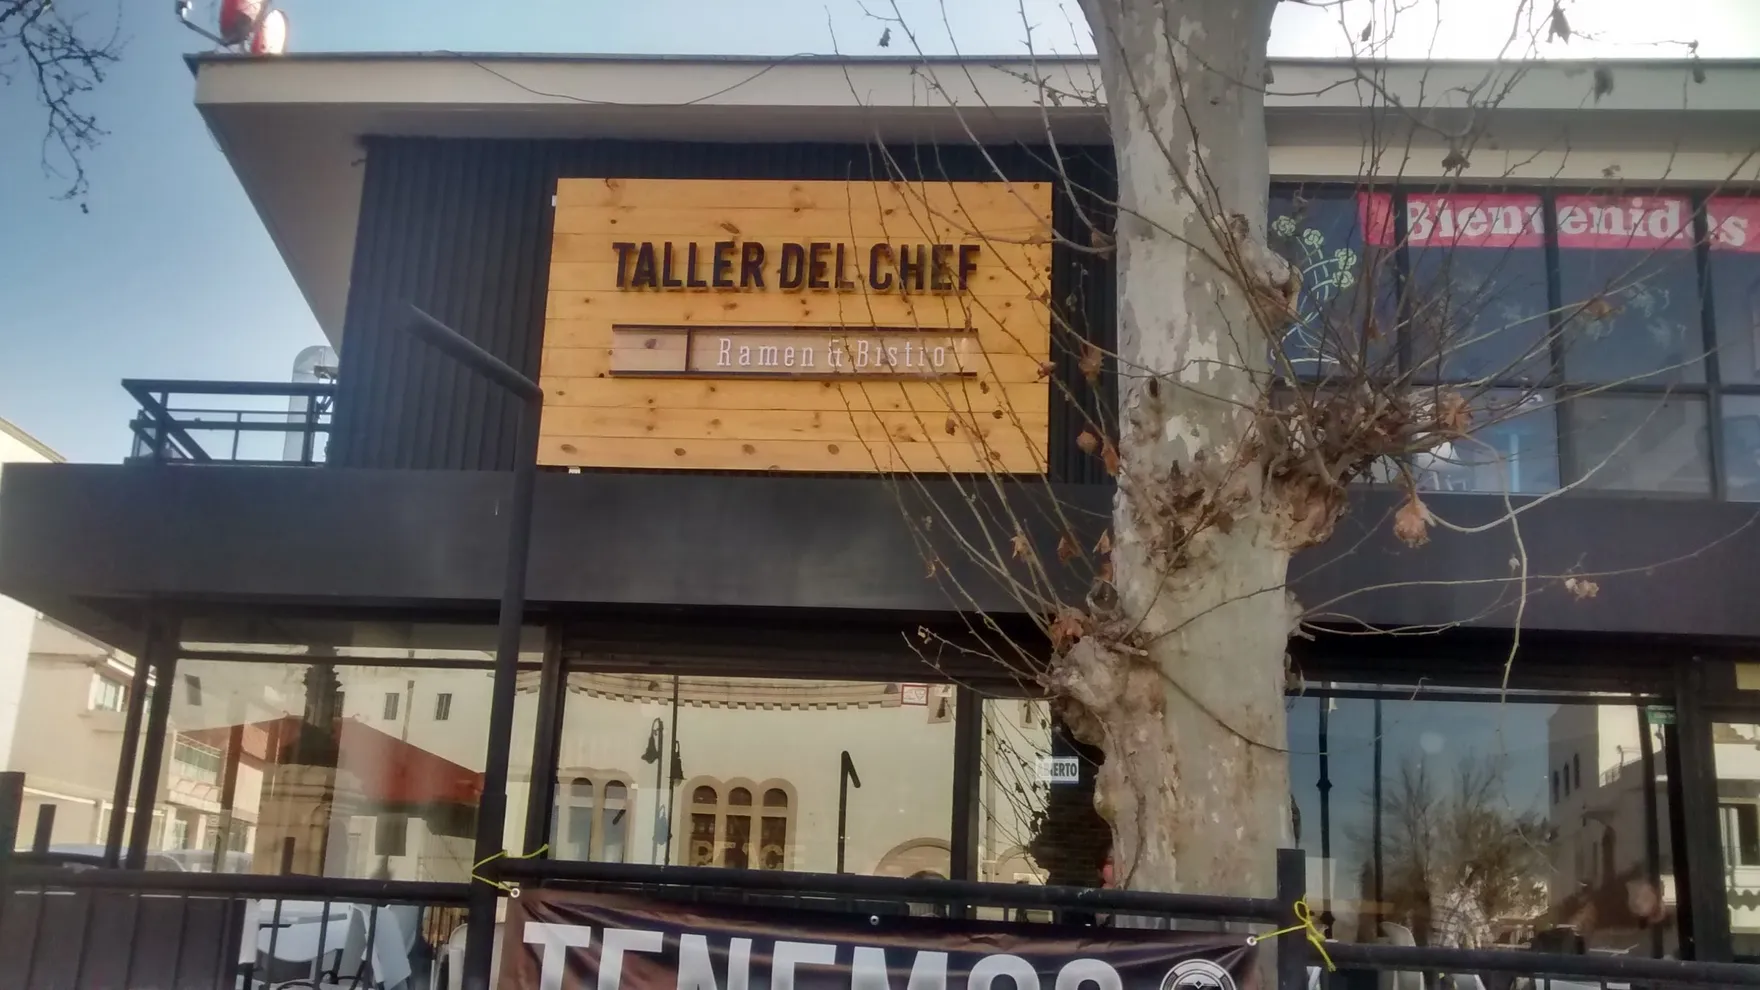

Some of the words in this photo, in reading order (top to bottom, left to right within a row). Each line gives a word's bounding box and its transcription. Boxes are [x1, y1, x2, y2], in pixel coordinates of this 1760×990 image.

[612, 241, 766, 289] TALLER
[779, 242, 855, 290] DEL
[869, 243, 981, 291] CHEF
[717, 337, 815, 367] Ramen
[828, 338, 844, 368] &
[857, 338, 945, 368] Bistro
